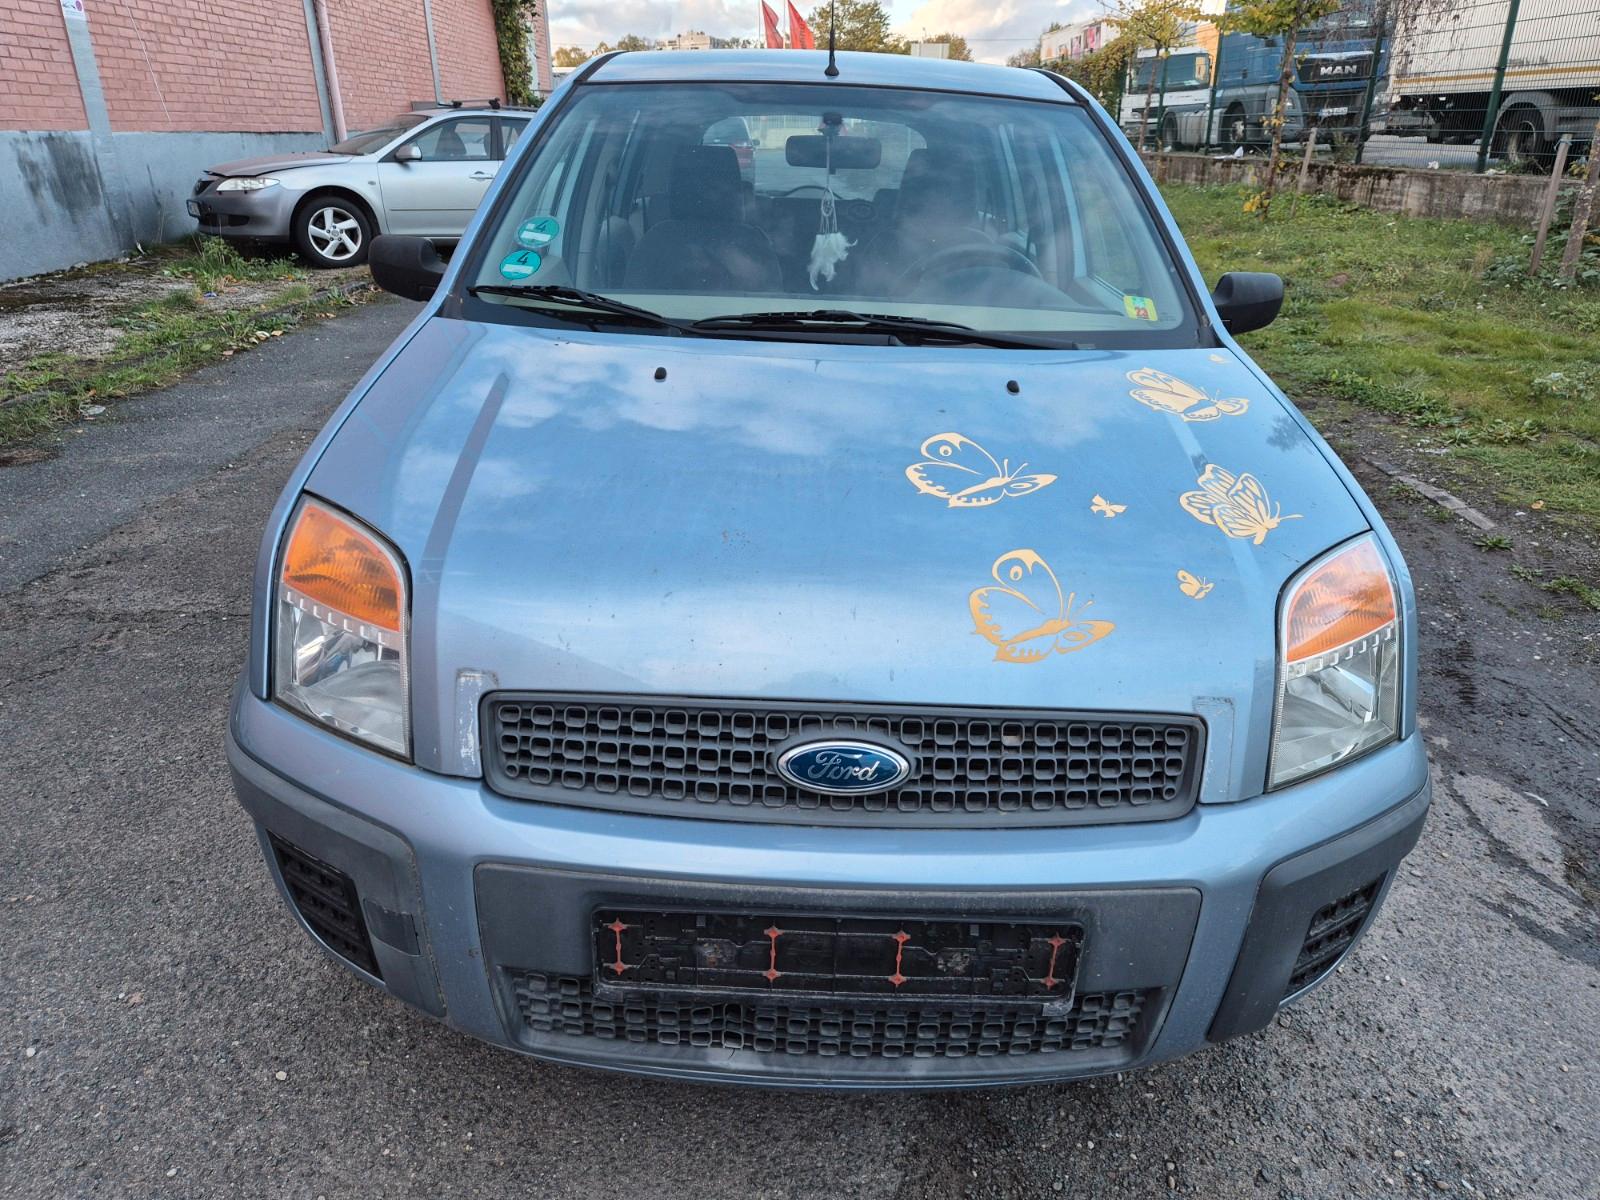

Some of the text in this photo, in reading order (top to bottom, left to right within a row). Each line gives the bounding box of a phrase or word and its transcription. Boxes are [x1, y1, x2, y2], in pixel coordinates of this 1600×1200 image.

[1320, 65, 1357, 75] MAN
[536, 220, 548, 232] 4
[517, 252, 530, 264] 4
[808, 751, 880, 781] Ford
